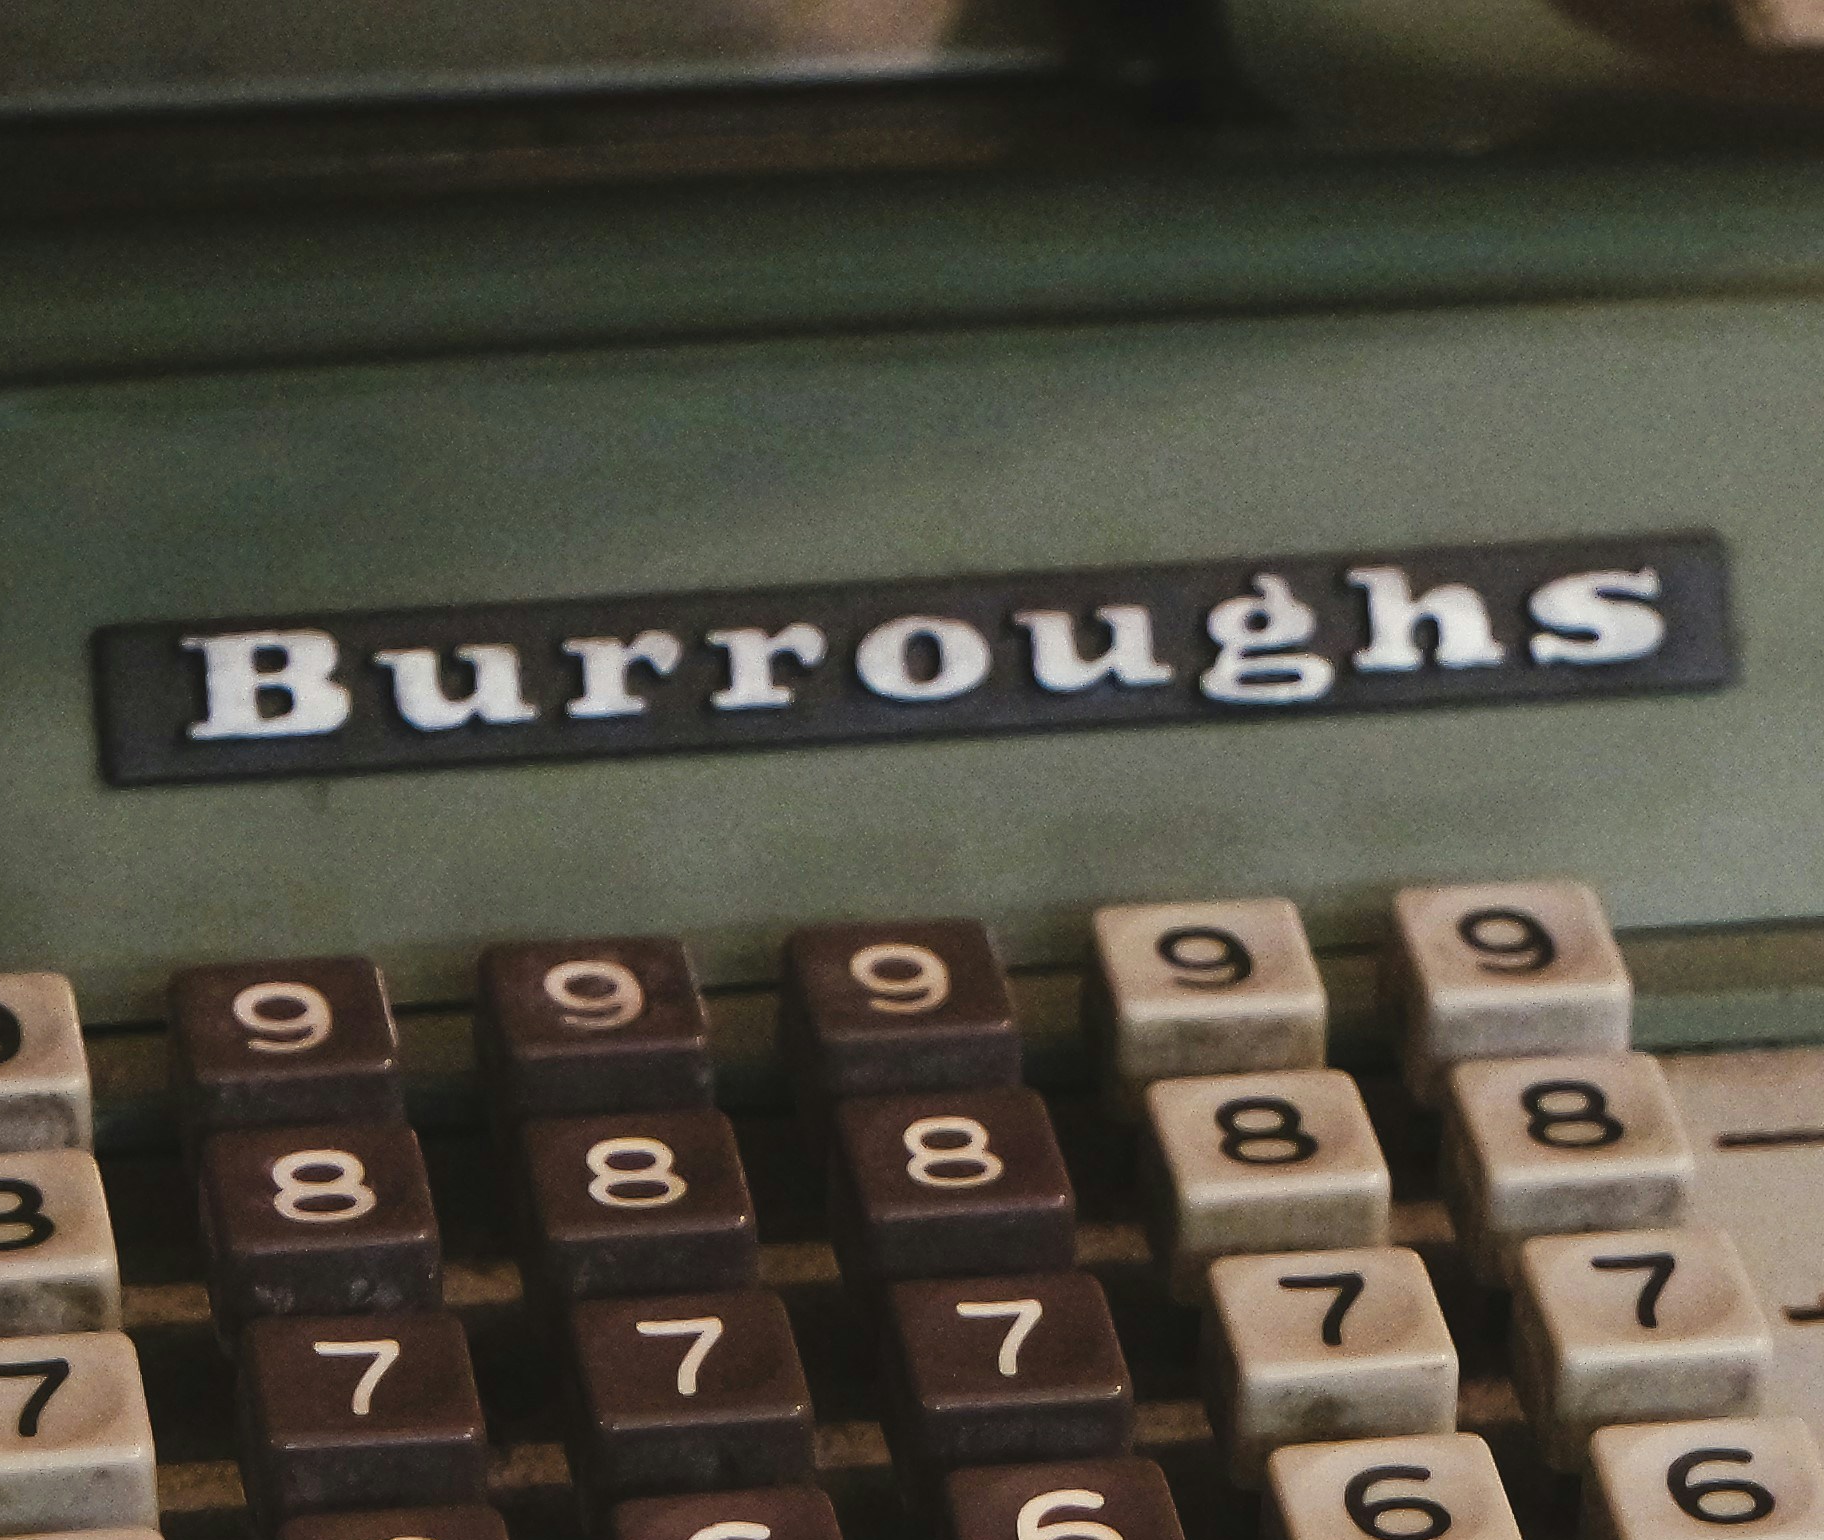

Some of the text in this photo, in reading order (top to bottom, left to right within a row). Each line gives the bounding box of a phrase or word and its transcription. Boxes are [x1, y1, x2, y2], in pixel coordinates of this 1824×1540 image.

[180, 565, 1667, 744] Burroughs
[1157, 926, 1251, 988] 9
[1458, 908, 1553, 974] 9
[543, 960, 644, 1029] 9
[849, 944, 951, 1012] 9
[233, 981, 332, 1052] 9
[1216, 1097, 1318, 1165] 8
[1521, 1080, 1623, 1148] 8
[272, 1149, 375, 1222] 8
[585, 1137, 687, 1209] 8
[903, 1116, 1002, 1186] 8
[1278, 1272, 1365, 1345] 7
[1591, 1253, 1675, 1328] 7
[635, 1316, 723, 1395] 7
[957, 1299, 1042, 1375] 7
[314, 1340, 400, 1414] 7
[1665, 1448, 1774, 1525] 6
